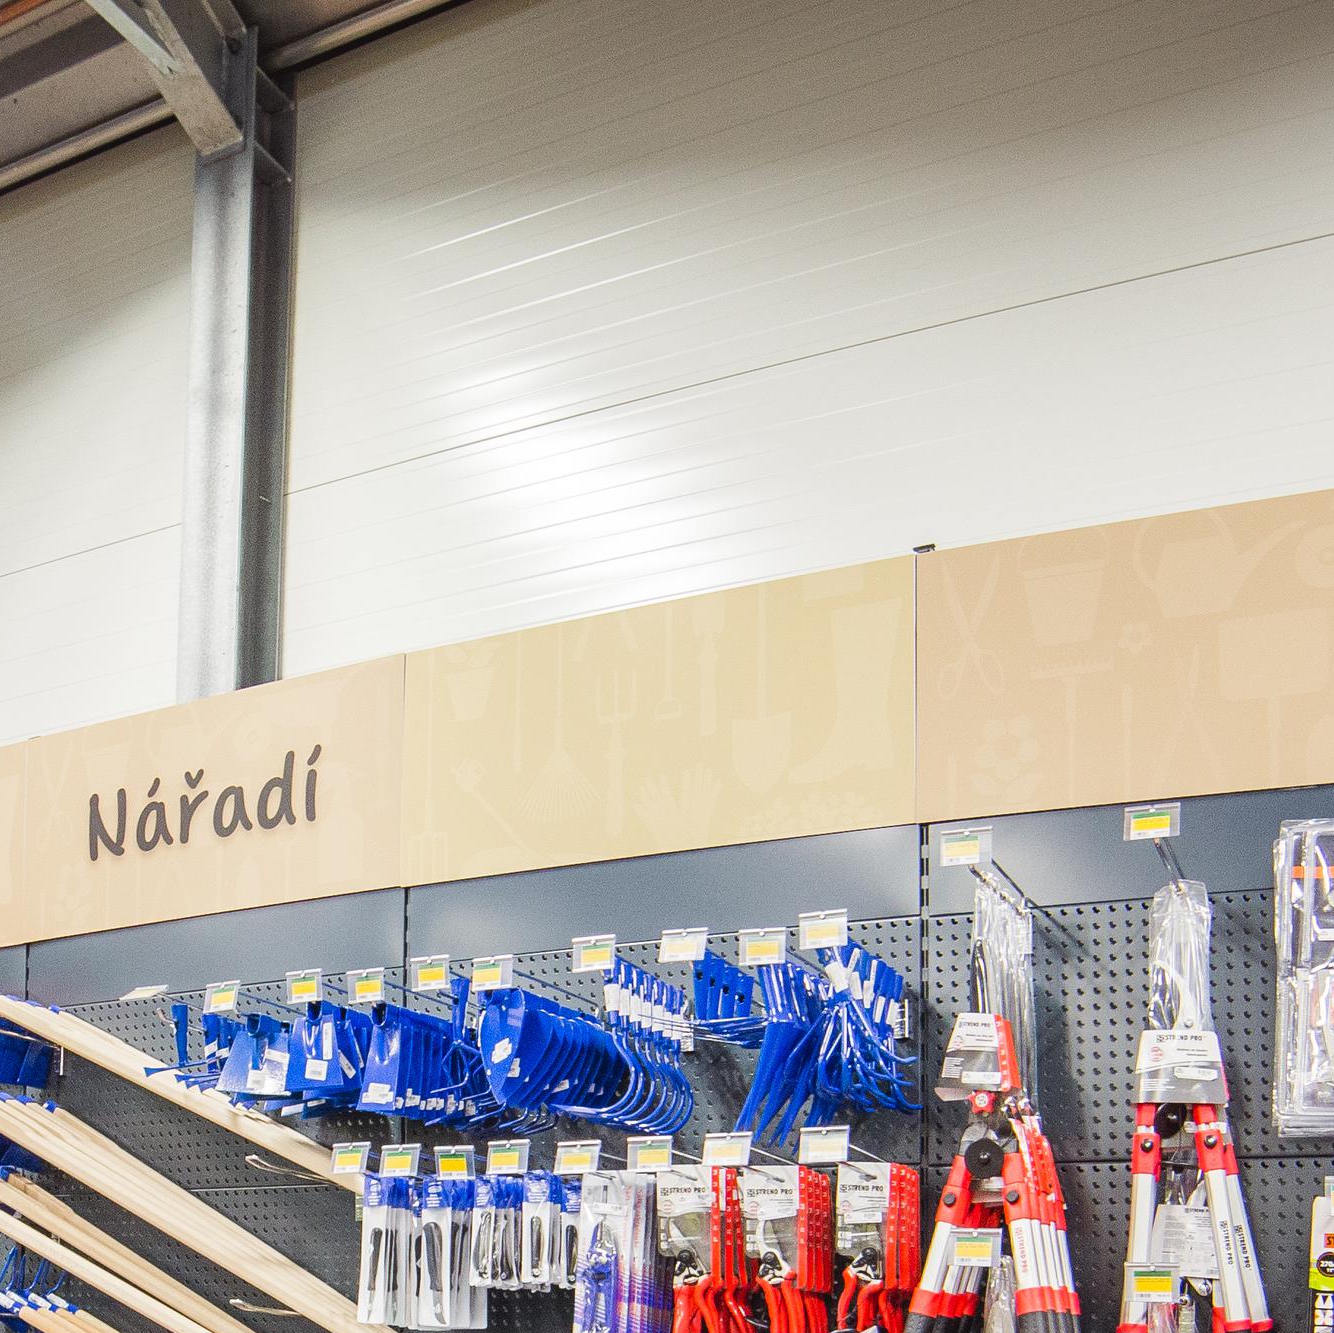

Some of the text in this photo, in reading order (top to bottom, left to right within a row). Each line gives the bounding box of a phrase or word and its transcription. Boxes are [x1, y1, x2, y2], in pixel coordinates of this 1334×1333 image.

[89, 744, 322, 862] Nářadí
[1223, 1229, 1232, 1251] STREND
[1237, 1233, 1252, 1269] STREND PRO
